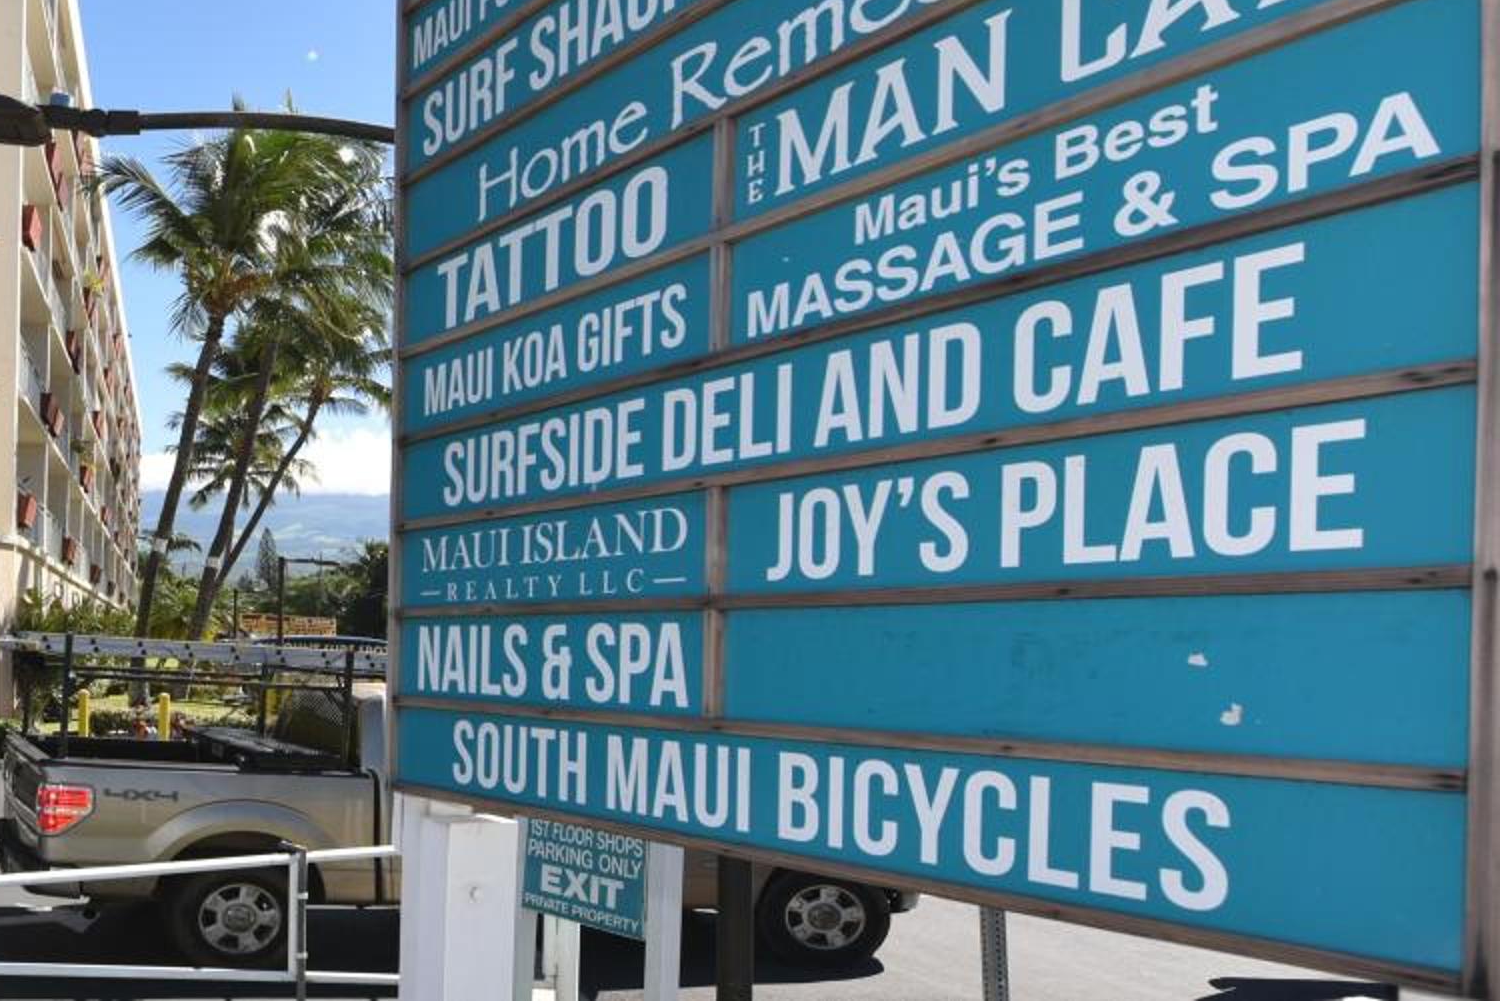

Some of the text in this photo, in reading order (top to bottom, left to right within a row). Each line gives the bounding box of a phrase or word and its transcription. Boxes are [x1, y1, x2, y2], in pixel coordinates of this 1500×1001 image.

[414, 0, 472, 69] MAUI
[423, 39, 517, 156] SURF
[746, 123, 766, 203] THE
[774, 8, 1011, 196] MAN
[477, 101, 648, 223] Home
[747, 91, 1441, 339] MASSAGE & SPA
[854, 85, 1219, 246] Maui's Best
[438, 165, 668, 329] TATTOO
[424, 283, 687, 417] MAUI KOA GIFTS
[443, 241, 1305, 506] SURFSIDE DELI AND CAFE
[422, 508, 688, 573] MAUI ISLAND
[766, 419, 1366, 581] JOY'S PLACE
[447, 568, 644, 603] REALTY LLC
[417, 622, 689, 708] NAILS & SPA
[453, 720, 1231, 910] SOUTH MAUI BICYCLES
[528, 839, 642, 879] PARKING ONLY
[531, 819, 643, 857] 1ST FLOOR SHOPS
[525, 892, 639, 932] PRIVATE PROPERTY
[540, 863, 624, 910] EXIT
